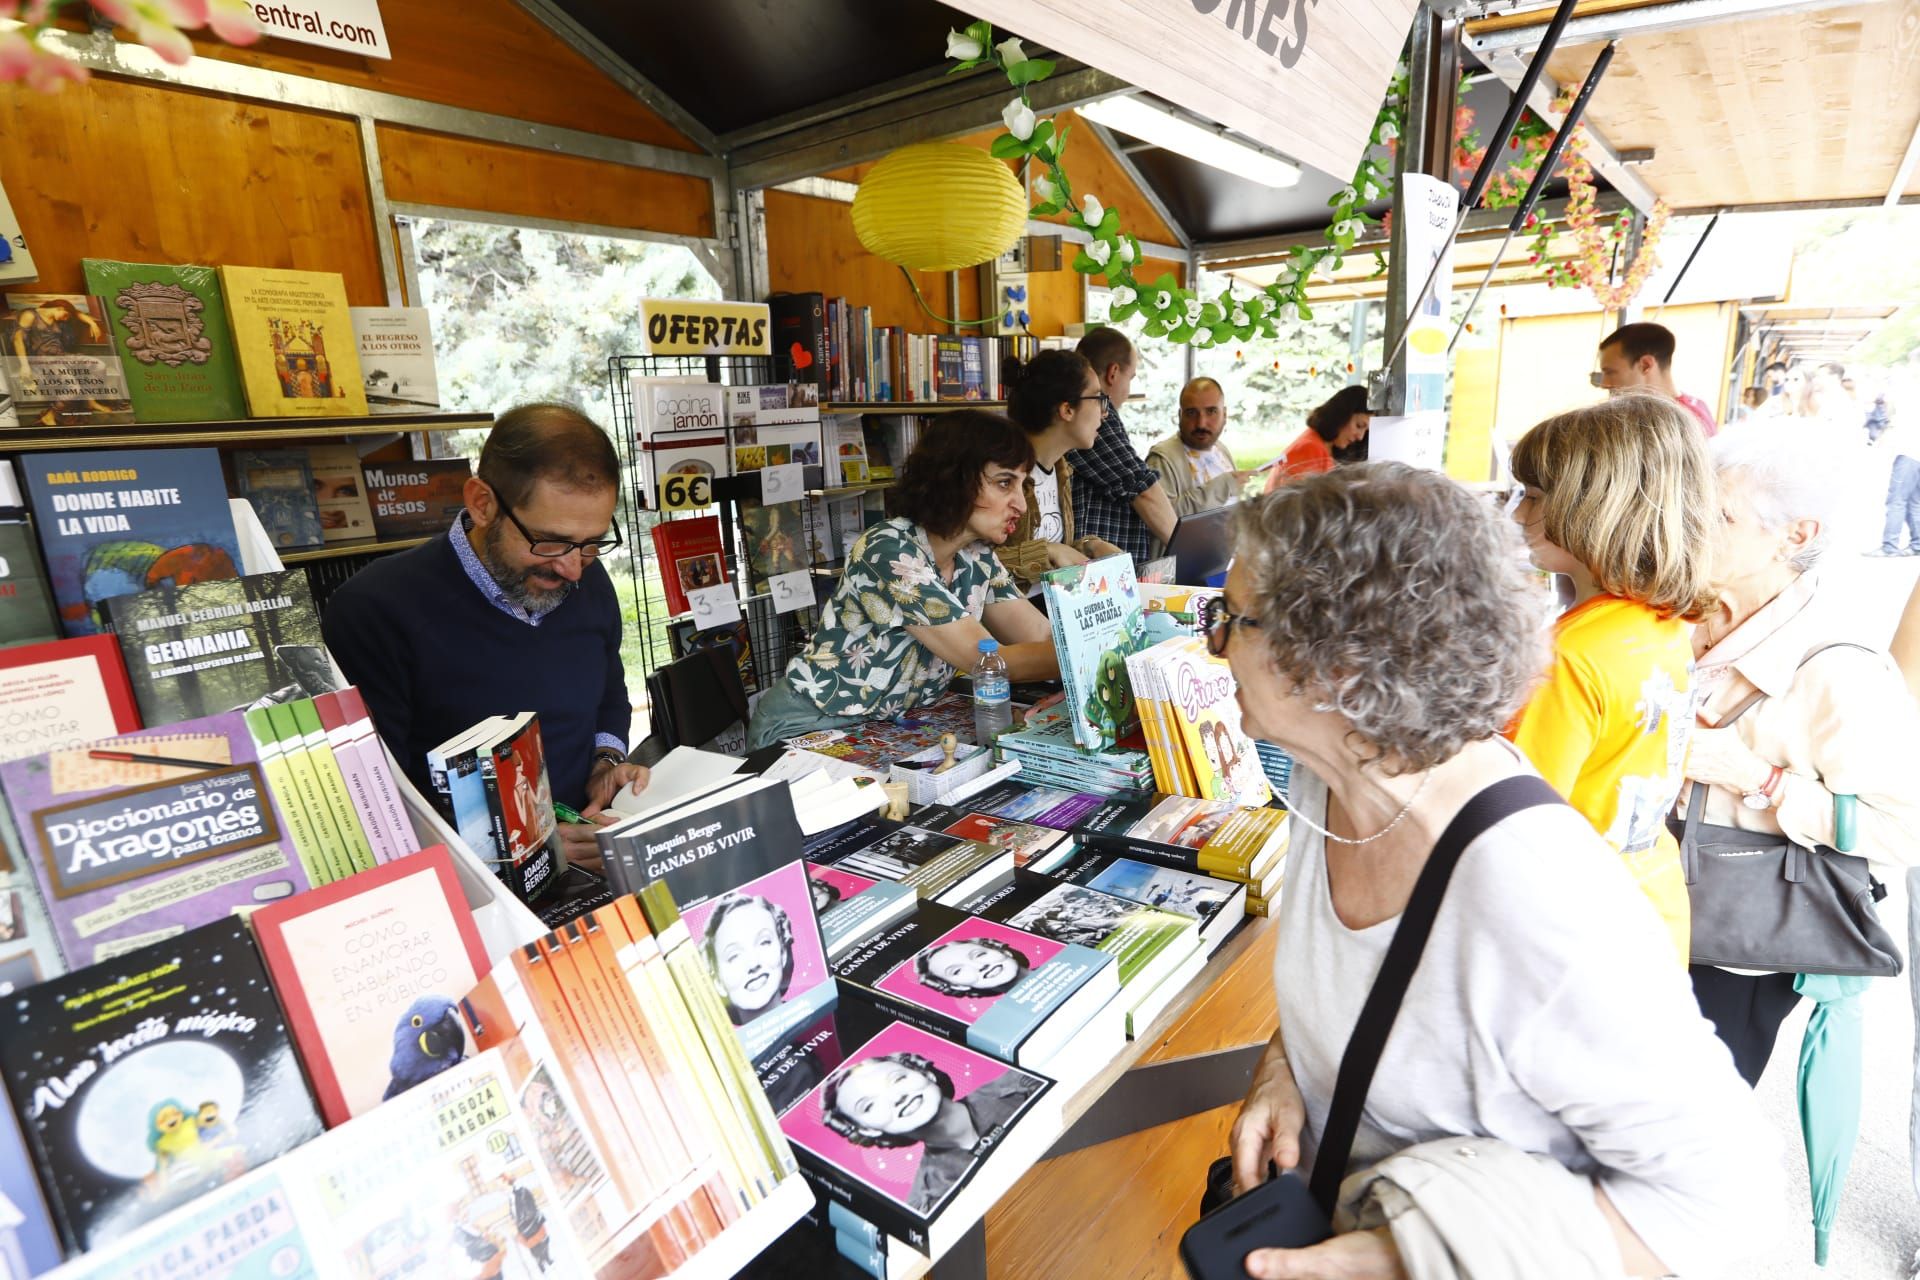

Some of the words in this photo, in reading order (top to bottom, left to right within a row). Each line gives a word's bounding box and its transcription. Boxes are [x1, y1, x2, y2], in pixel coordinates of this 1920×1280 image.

[244, 0, 377, 46] entral.com
[1192, 0, 1318, 69] ES
[362, 334, 374, 342] EL
[648, 313, 767, 348] OFERTAS
[370, 343, 388, 351] LOS
[42, 368, 55, 376] LA
[58, 368, 91, 377] MUJER
[65, 377, 105, 386] SUEÑOS
[23, 389, 37, 397] EN
[55, 387, 119, 397] ROMANCERO
[656, 394, 712, 416] cocina
[672, 410, 718, 433] jamón
[47, 470, 81, 485] RAÚL
[82, 469, 138, 483] RODRIGO
[664, 476, 710, 507] 6€
[52, 492, 117, 512] DONDE
[117, 488, 182, 508] HABITE
[376, 501, 427, 517] BESOS
[377, 488, 396, 502] de
[58, 517, 84, 536] LA
[83, 514, 132, 534] VIDA
[776, 580, 793, 600] 3
[136, 613, 189, 633] MANUEL
[190, 603, 244, 623] CEBRIÁN
[245, 594, 293, 613] ABELLÁN
[693, 596, 713, 616] 3
[1073, 609, 1083, 620] LA
[1083, 601, 1106, 616] GUERRA
[1106, 597, 1114, 607] DE
[1079, 616, 1094, 631] LAS
[1095, 606, 1123, 625] PATATAS
[144, 629, 251, 665] GERMANIA
[151, 671, 161, 680] EL
[161, 664, 194, 677] AMARGO
[193, 656, 233, 671] DESPERTAR
[233, 655, 244, 665] DE
[243, 650, 265, 662] ROMA
[0, 719, 81, 746] RONTAR
[46, 791, 226, 847] Diccionario
[231, 787, 257, 802] de
[66, 803, 261, 874] Aragonés
[171, 840, 208, 858] para
[208, 824, 263, 847] foranos
[645, 834, 687, 862] Joaquín
[687, 821, 722, 842] Berges
[647, 848, 697, 878] GANAS
[696, 841, 718, 860] DE
[716, 826, 757, 850] VIVIR
[523, 849, 551, 882] JOAQUÍN
[524, 863, 551, 894] BERGES
[331, 931, 433, 984] ENAMORAR
[830, 945, 861, 972] Joaquín
[859, 930, 886, 948] Berges
[840, 949, 878, 976] GANAS
[873, 938, 892, 952] DE
[889, 921, 919, 942] VIVIR
[342, 950, 438, 1001] HABLANDO
[344, 1001, 374, 1023] EN
[377, 967, 448, 1007] PÚBLICO
[758, 1073, 780, 1090] AS
[780, 1056, 799, 1075] DE
[795, 1030, 834, 1058] VIVIR
[760, 1044, 793, 1071] Berges
[202, 1195, 281, 1249] PARDA
